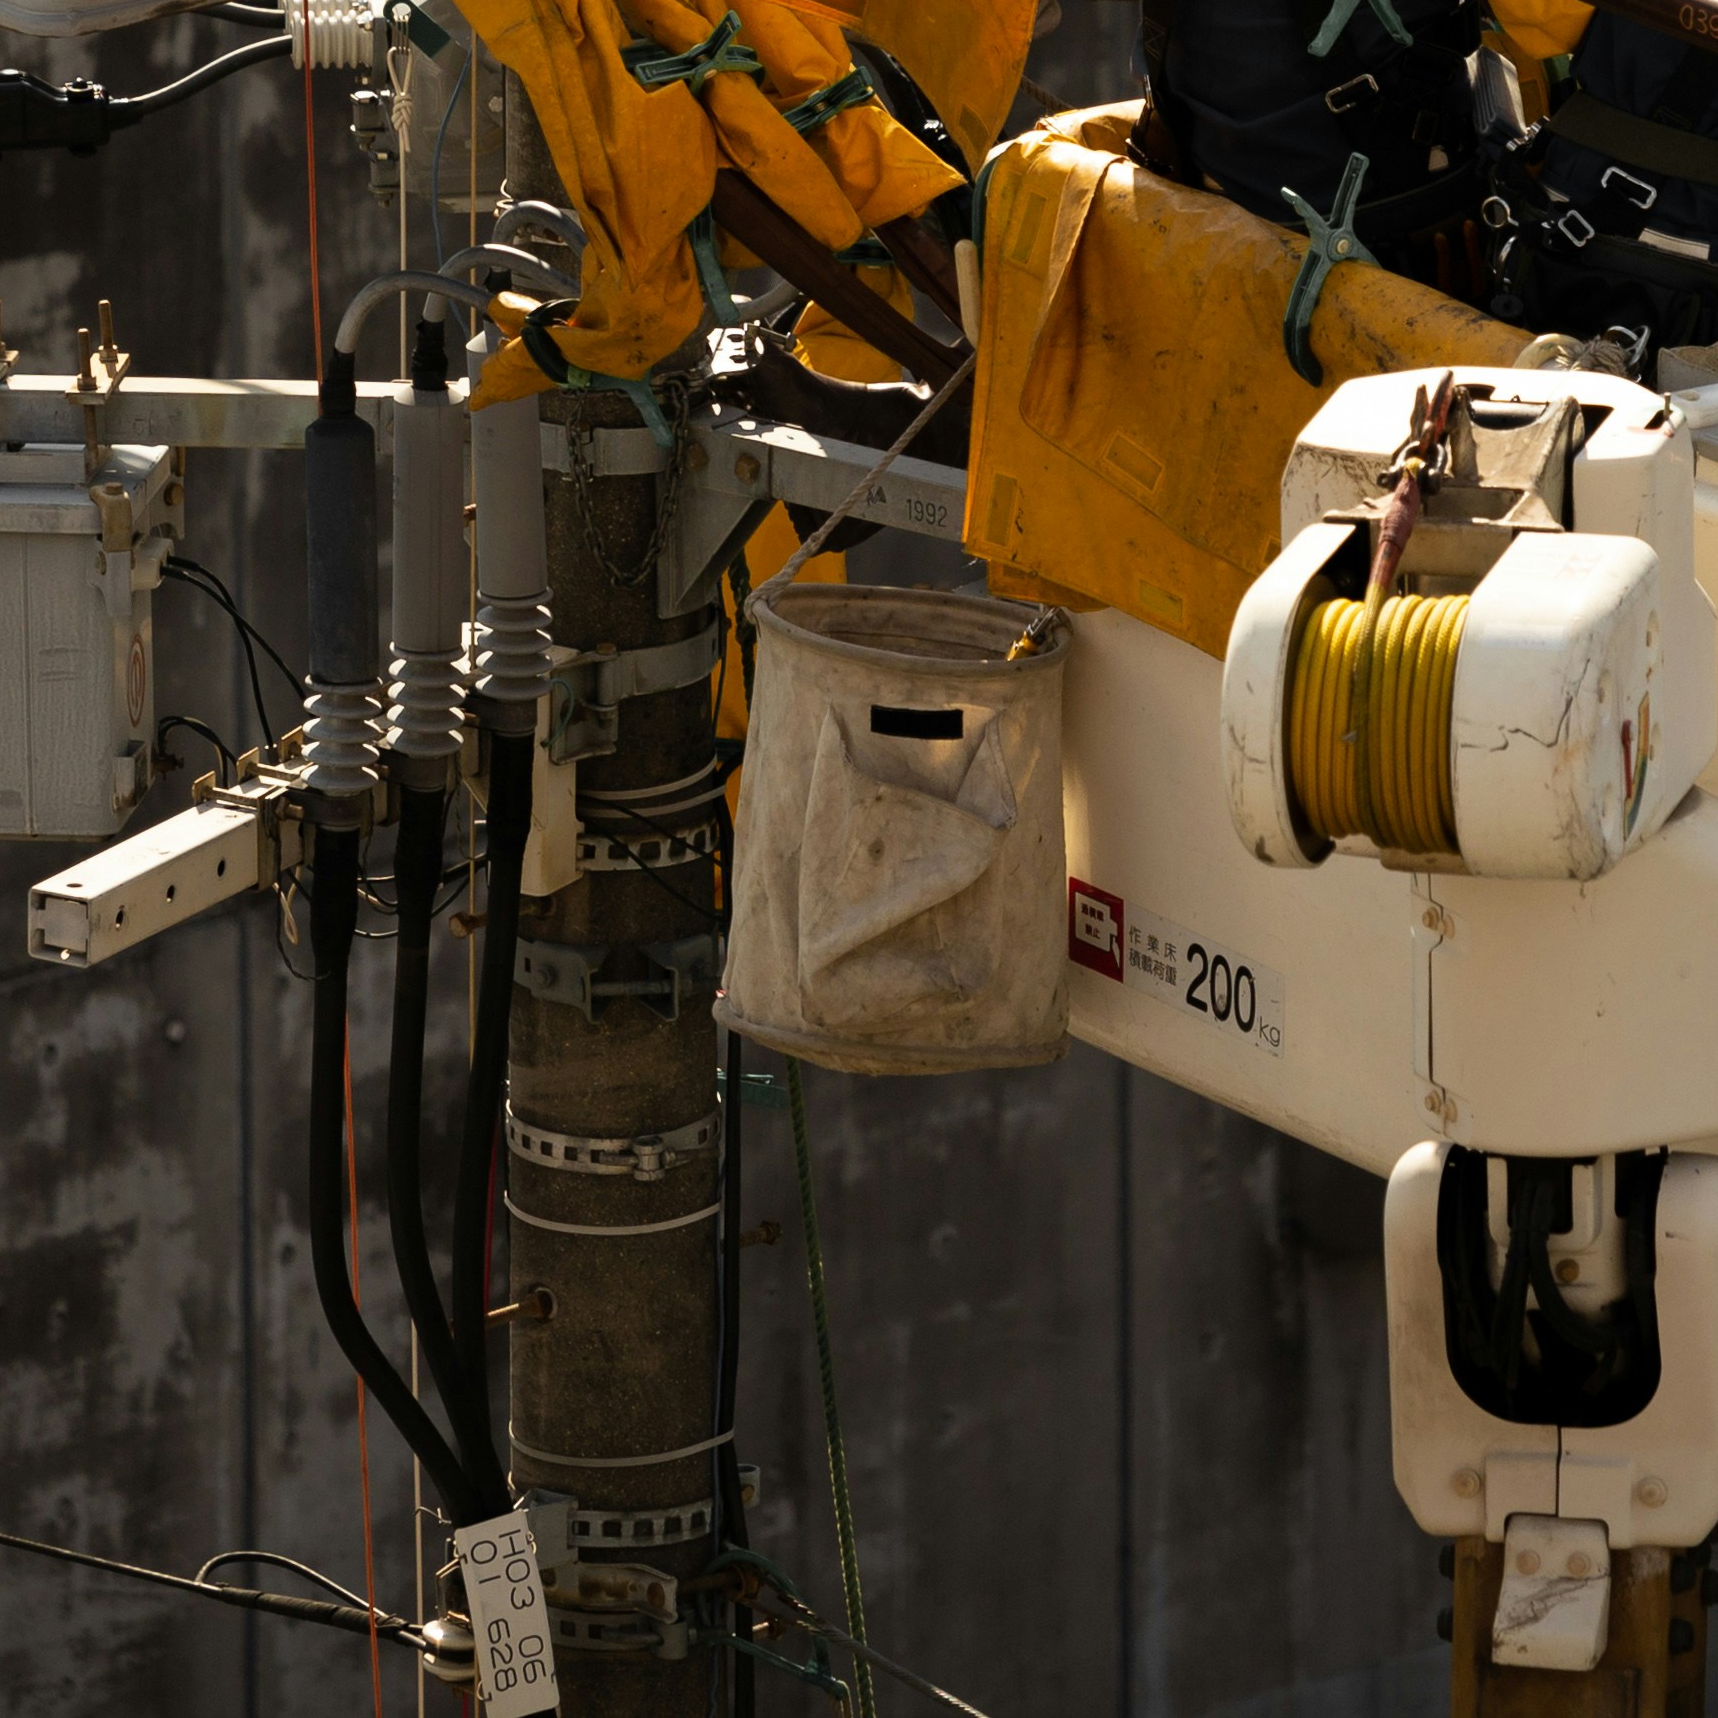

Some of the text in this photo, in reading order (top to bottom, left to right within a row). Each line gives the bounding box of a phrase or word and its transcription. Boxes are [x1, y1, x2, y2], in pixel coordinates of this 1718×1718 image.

[906, 498, 948, 528] 1992
[1129, 925, 1178, 963] 作業床
[1129, 948, 1178, 986] 積載荷重
[1186, 943, 1281, 1047] 200 kg
[499, 1528, 547, 1684] H03 06
[487, 1618, 518, 1693] 628
